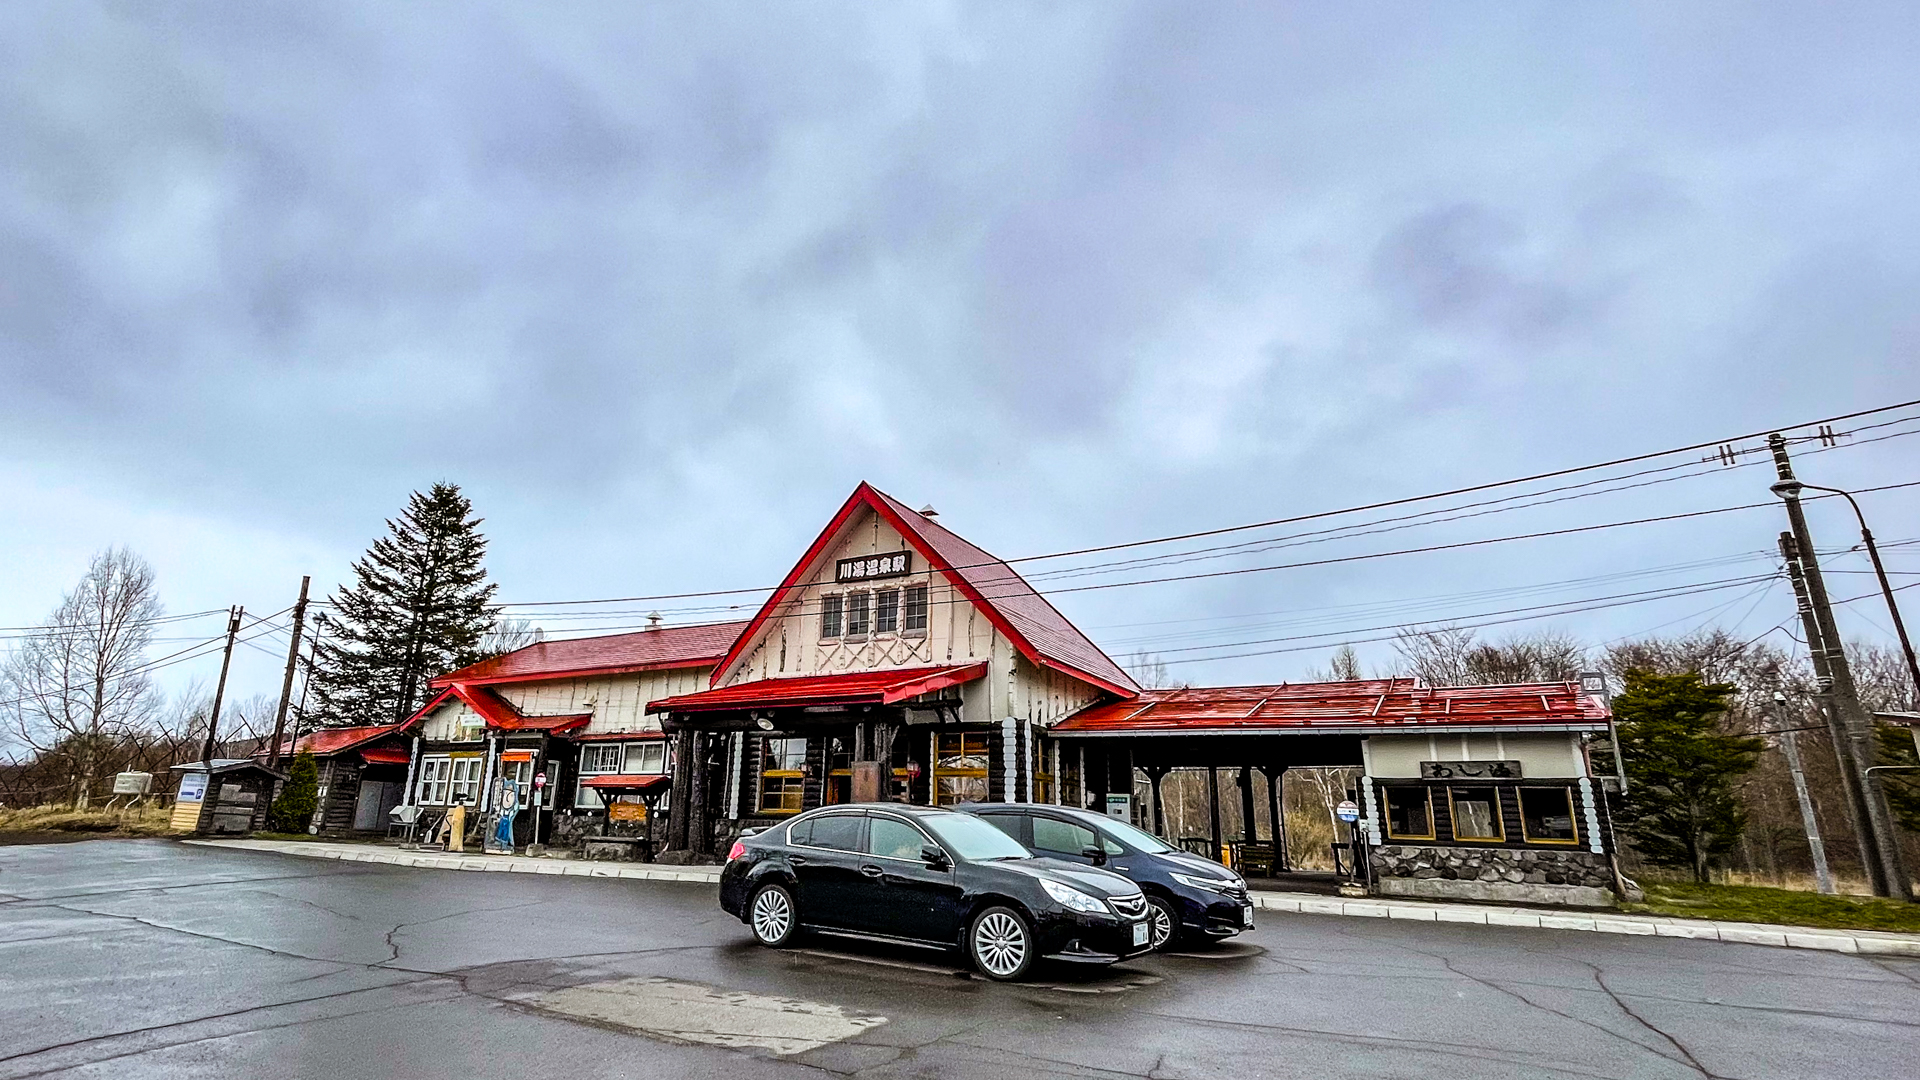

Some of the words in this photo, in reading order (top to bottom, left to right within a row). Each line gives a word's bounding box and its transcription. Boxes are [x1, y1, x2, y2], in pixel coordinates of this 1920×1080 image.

[839, 555, 905, 579] 川湯温泉駅
